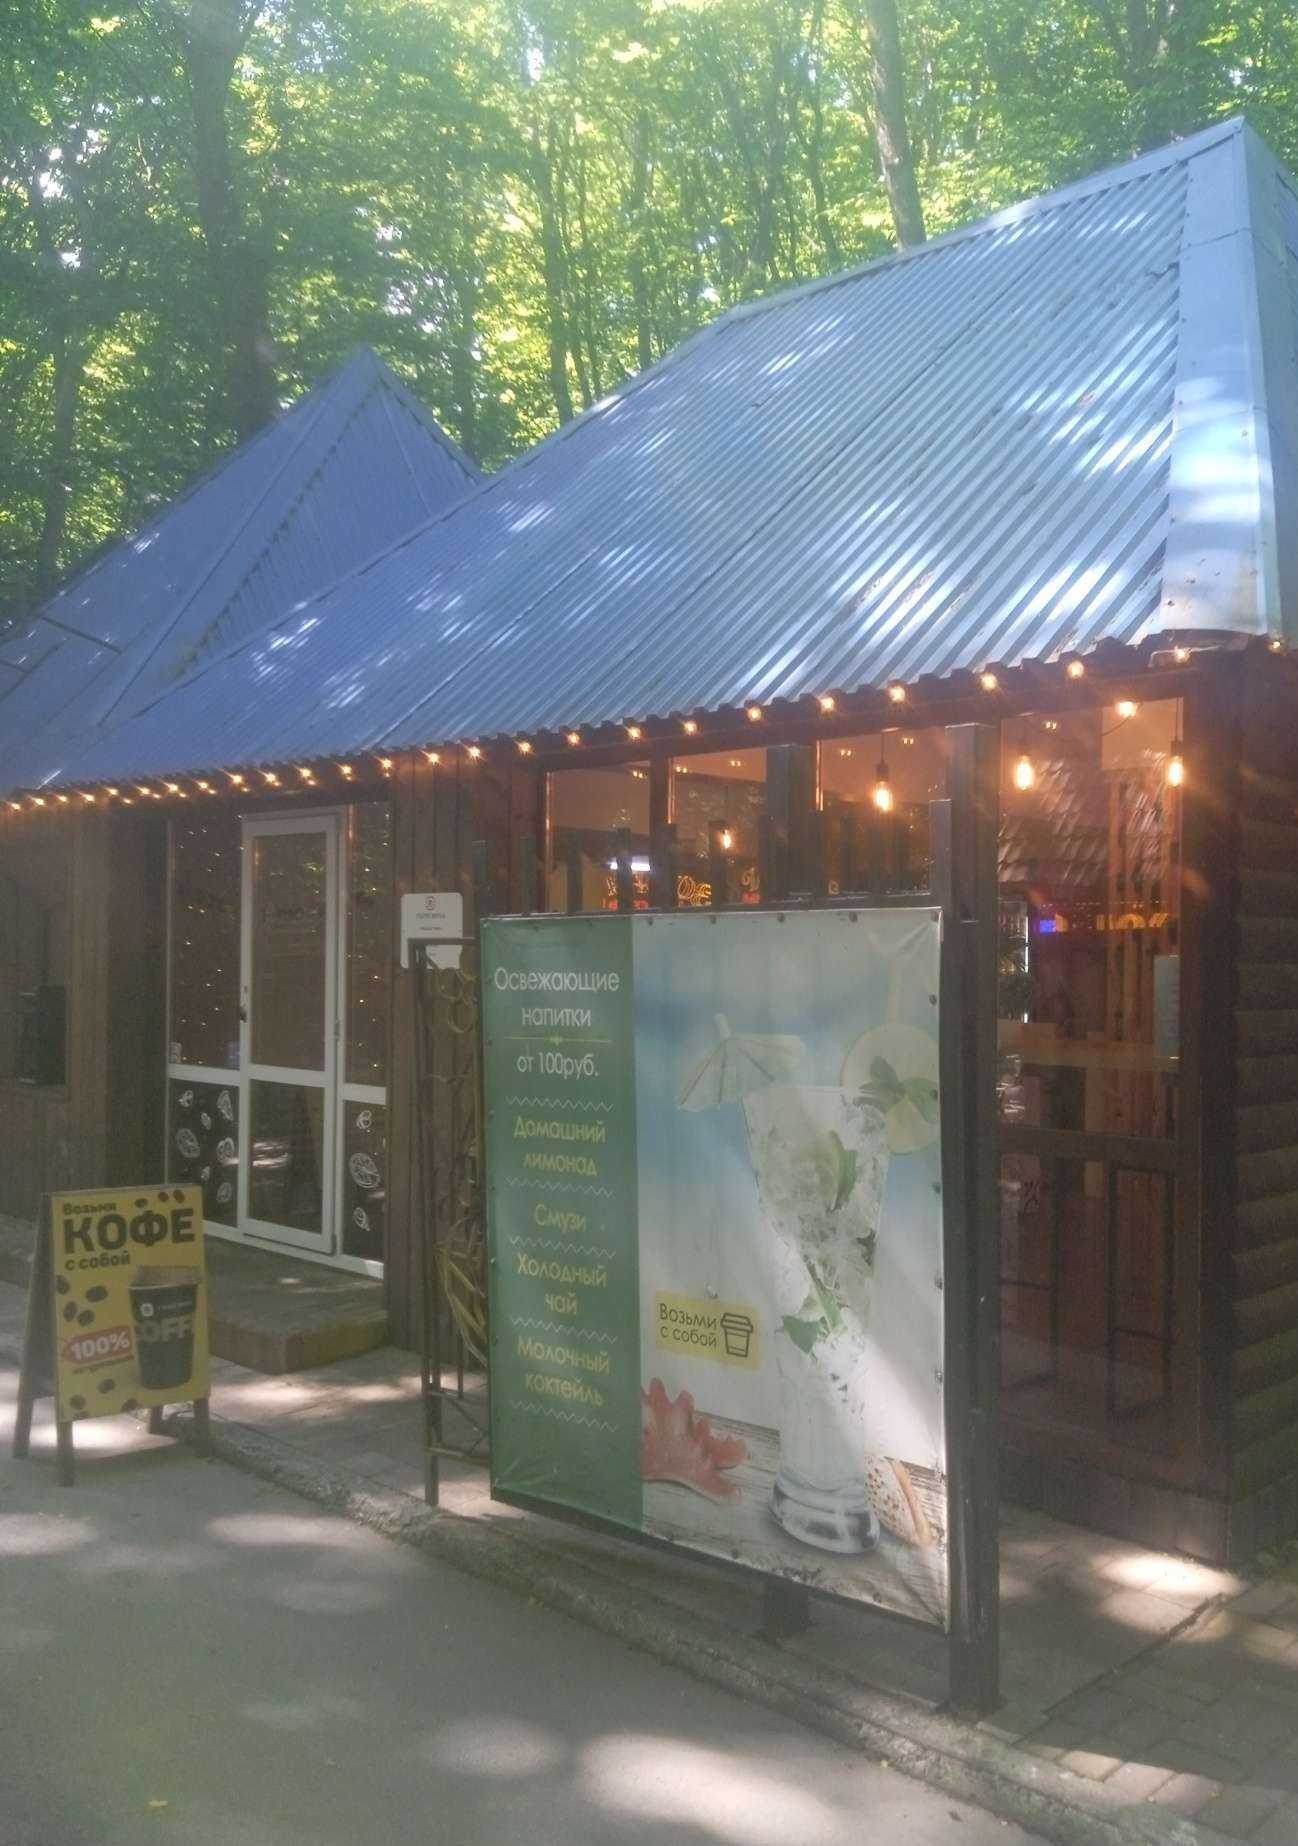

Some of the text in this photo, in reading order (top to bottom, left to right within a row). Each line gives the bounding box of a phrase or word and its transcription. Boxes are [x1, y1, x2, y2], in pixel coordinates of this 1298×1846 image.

[494, 966, 620, 993] Освежающие
[521, 1007, 592, 1028] напитки
[516, 1052, 600, 1080] от 100руб.
[513, 1115, 606, 1144] Домашний
[523, 1151, 598, 1177] лимонад
[63, 1208, 196, 1254] КОФЕ
[534, 1203, 587, 1233] Смузи
[79, 1250, 131, 1270] собой
[517, 1252, 607, 1288] Холодный
[545, 1293, 577, 1315] чай
[659, 1303, 717, 1330] Возьми
[71, 1331, 130, 1361] 100%
[660, 1326, 717, 1347] с собой
[517, 1335, 611, 1374] Молочный
[524, 1372, 603, 1408] коктейль
